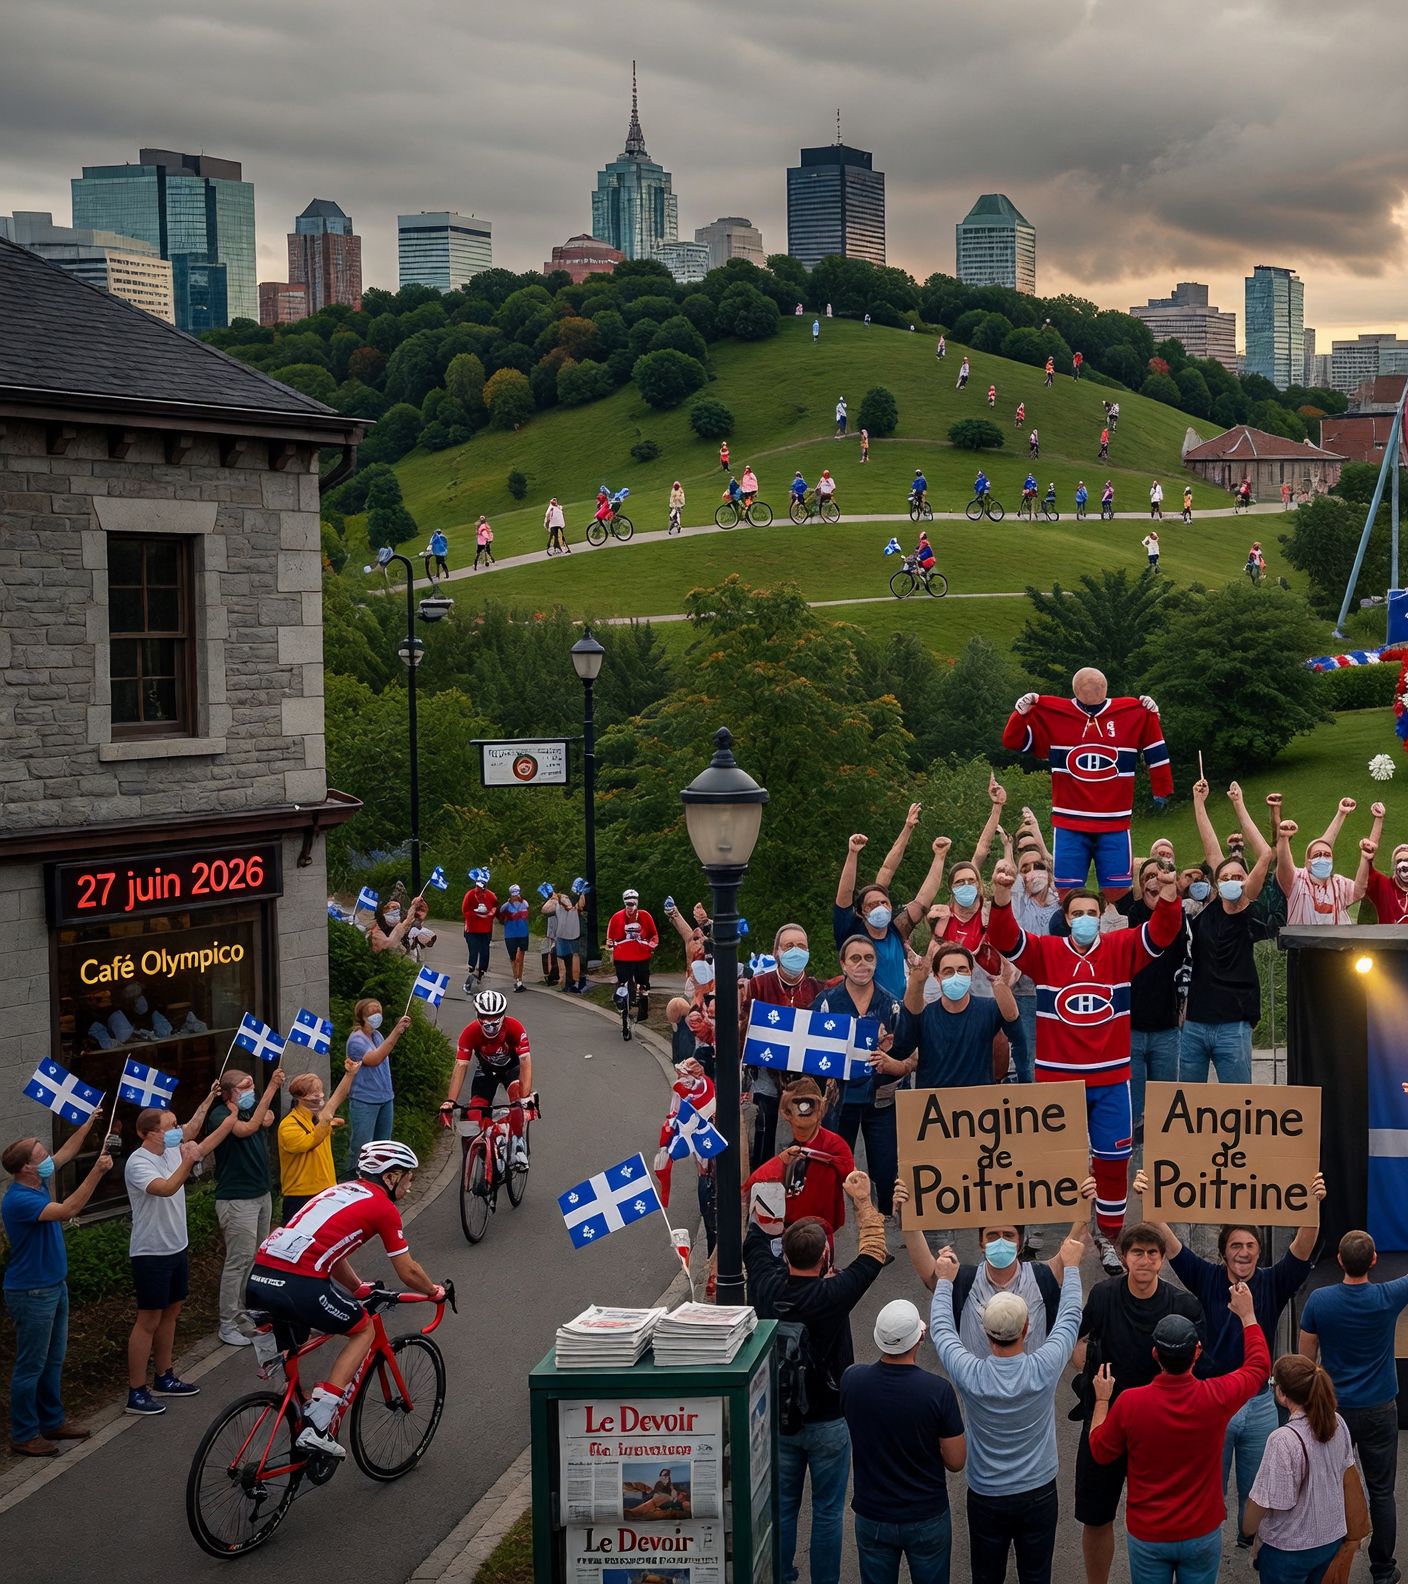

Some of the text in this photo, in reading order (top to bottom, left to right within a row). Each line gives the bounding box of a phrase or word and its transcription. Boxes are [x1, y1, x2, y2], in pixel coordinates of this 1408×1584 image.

[76, 855, 265, 912] 27 juin 2026
[80, 940, 245, 985] Café Olympico
[916, 1093, 1067, 1153] Angine
[1161, 1089, 1304, 1150] Angine
[977, 1150, 1013, 1169] de
[1211, 1148, 1247, 1168] de
[912, 1164, 1078, 1217] Poitrine
[1153, 1159, 1308, 1212] Poitrine
[584, 1405, 699, 1433] Le Devoir
[583, 1526, 694, 1553] Le Devoir
